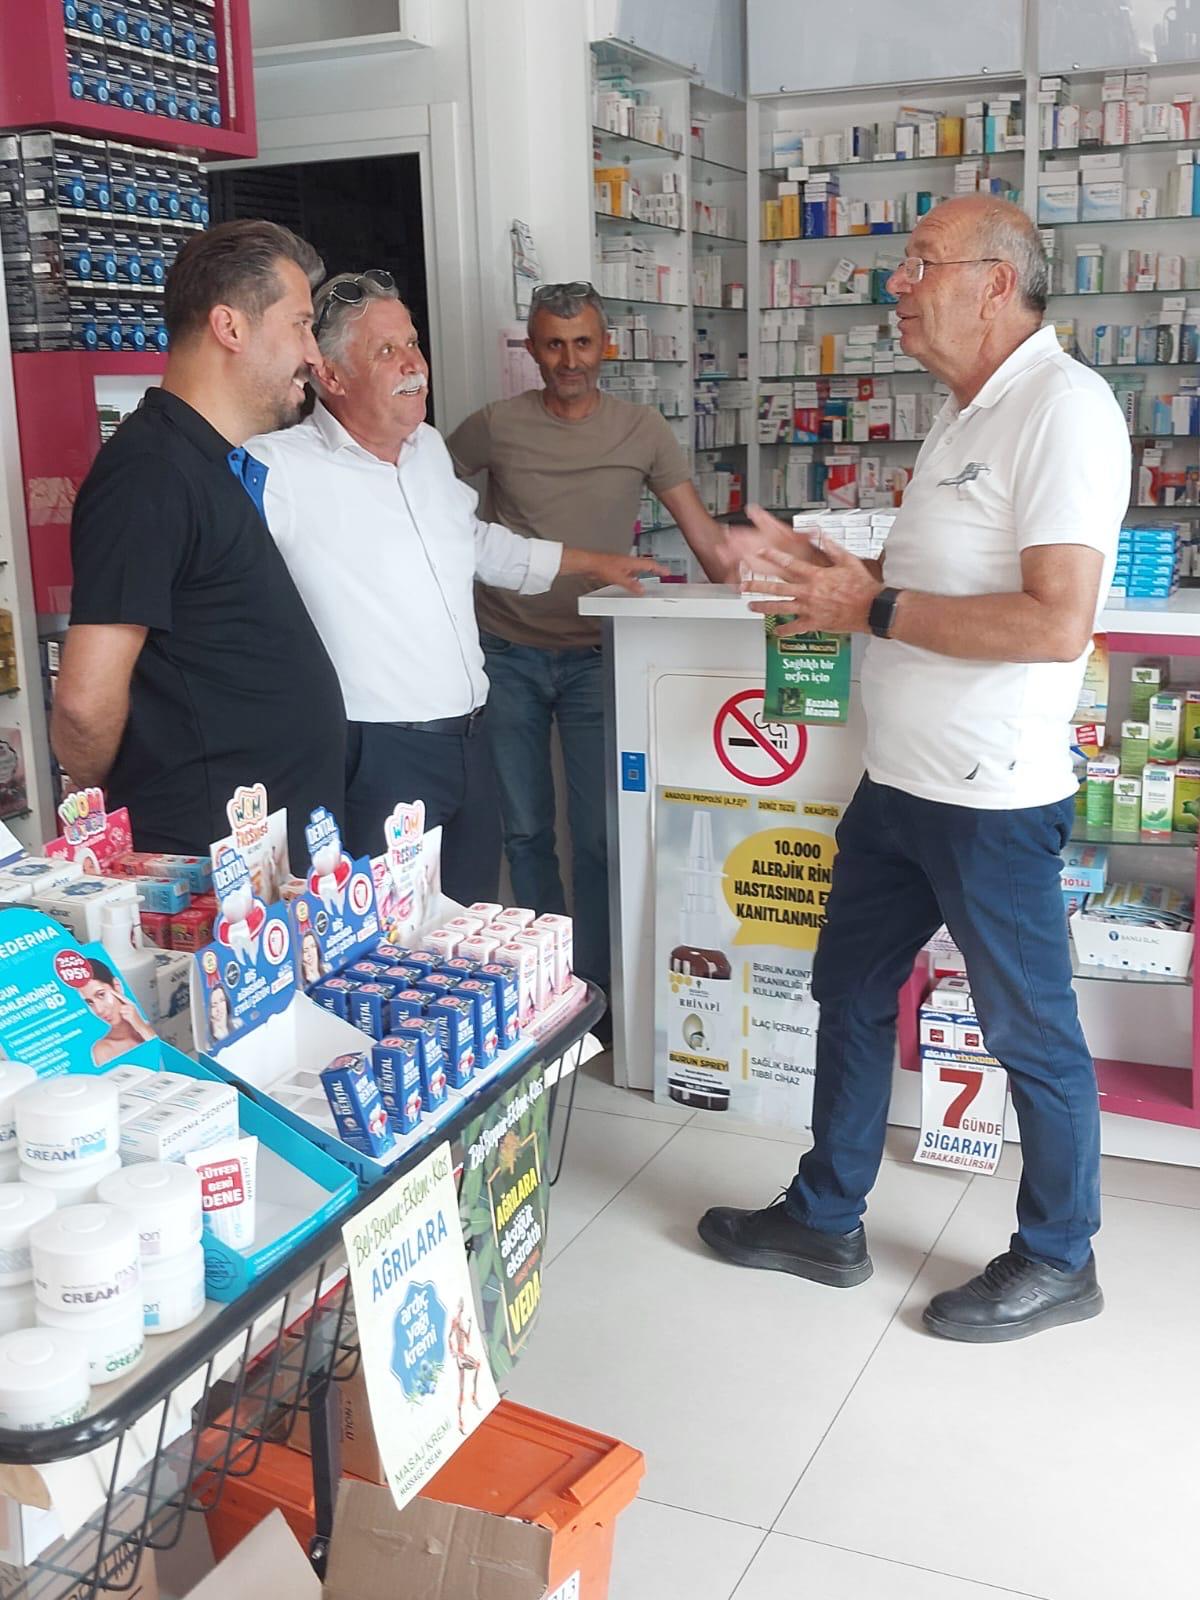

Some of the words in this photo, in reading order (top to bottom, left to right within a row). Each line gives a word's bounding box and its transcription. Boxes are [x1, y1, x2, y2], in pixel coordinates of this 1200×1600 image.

[782, 658, 819, 671] Sağlıklı
[820, 659, 836, 670] bir
[784, 671, 811, 683] nefes
[811, 672, 831, 684] için
[774, 839, 822, 860] 10.000
[751, 859, 805, 881] ALERJİK
[734, 879, 815, 906] HASTASINDA
[752, 962, 784, 975] BURUN
[752, 974, 804, 991] TIKANIKLIĞI
[752, 986, 804, 1002] KULLANILIR
[751, 1016, 772, 1032] İLAÇ
[669, 1053, 698, 1067] BURUN
[751, 1057, 782, 1071] SAĞLIK
[383, 1056, 394, 1094] DENTAL
[751, 1068, 773, 1080] TIBBİ
[774, 1073, 801, 1086] CİHAZ
[332, 1079, 351, 1116] DENTAL
[939, 1067, 984, 1129] 7
[962, 1117, 1002, 1137] GÜNDE
[25, 1148, 77, 1161] CREAM
[924, 1129, 998, 1160] SİGARAYI
[919, 1150, 996, 1171] BIRAKABİLİRSİN
[200, 1163, 240, 1180] LÜTFEN
[202, 1188, 244, 1208] DENE
[495, 1167, 539, 1231] AĞRILARA
[501, 1204, 535, 1259] aksöğüt
[371, 1209, 448, 1303] AĞRILARA
[61, 1285, 120, 1304] CREAM
[508, 1269, 542, 1336] VEDA
[400, 1289, 431, 1326] ardıç
[405, 1312, 430, 1347] yağı
[403, 1322, 438, 1369] kremi
[393, 1447, 426, 1487] MASAJ
[399, 1468, 425, 1498] MASSAGE
[423, 1447, 443, 1476] CREAM
